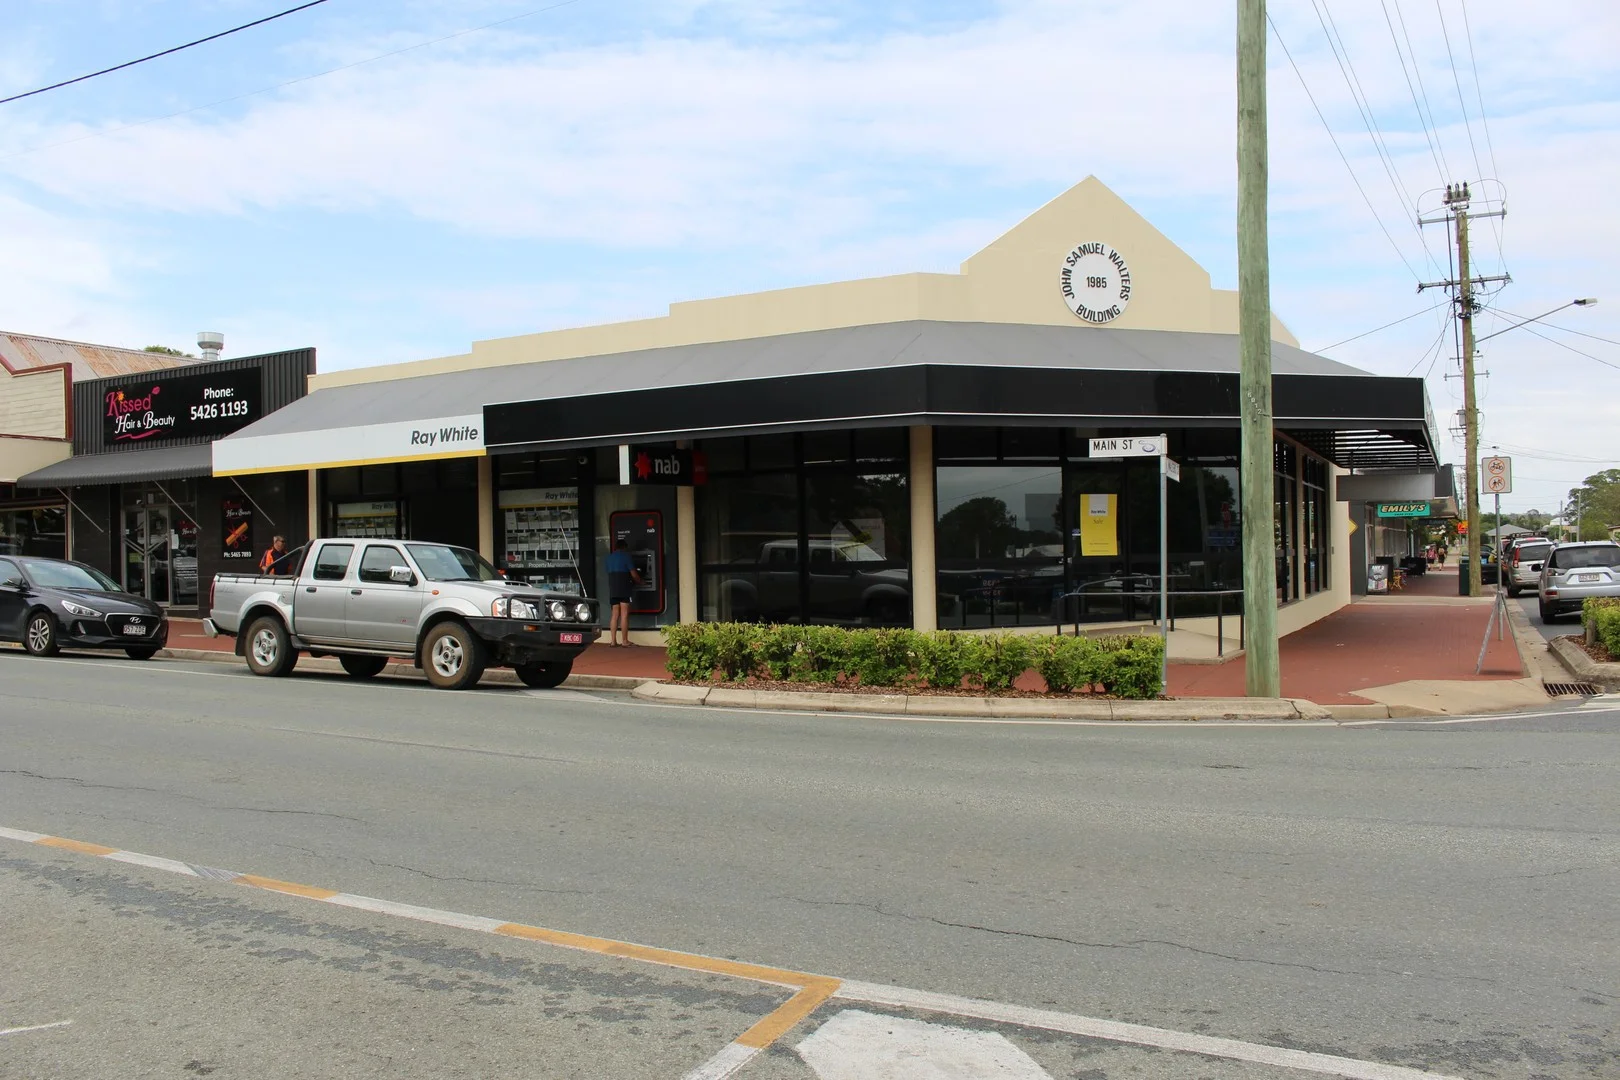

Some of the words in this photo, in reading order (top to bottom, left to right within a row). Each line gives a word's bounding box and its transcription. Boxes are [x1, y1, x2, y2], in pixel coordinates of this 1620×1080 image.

[1066, 243, 1105, 267] SAMUEL
[1062, 268, 1075, 299] JOHN
[1086, 276, 1107, 288] 1985
[1108, 250, 1131, 301] WALTERS
[1076, 304, 1121, 323] BUILDING
[106, 391, 152, 417] Kissed
[204, 388, 234, 400] Phone:
[190, 404, 217, 420] 5426
[220, 400, 248, 416] 1193
[114, 413, 135, 434] Hair
[137, 420, 142, 428] &
[143, 411, 176, 429] Beauty
[411, 430, 437, 447] Ray
[439, 425, 479, 443] White
[1093, 440, 1117, 451] MAIN
[1122, 439, 1134, 450] ST
[654, 455, 680, 475] nab
[545, 491, 558, 501] Ray
[1381, 504, 1426, 513] EMILY'S
